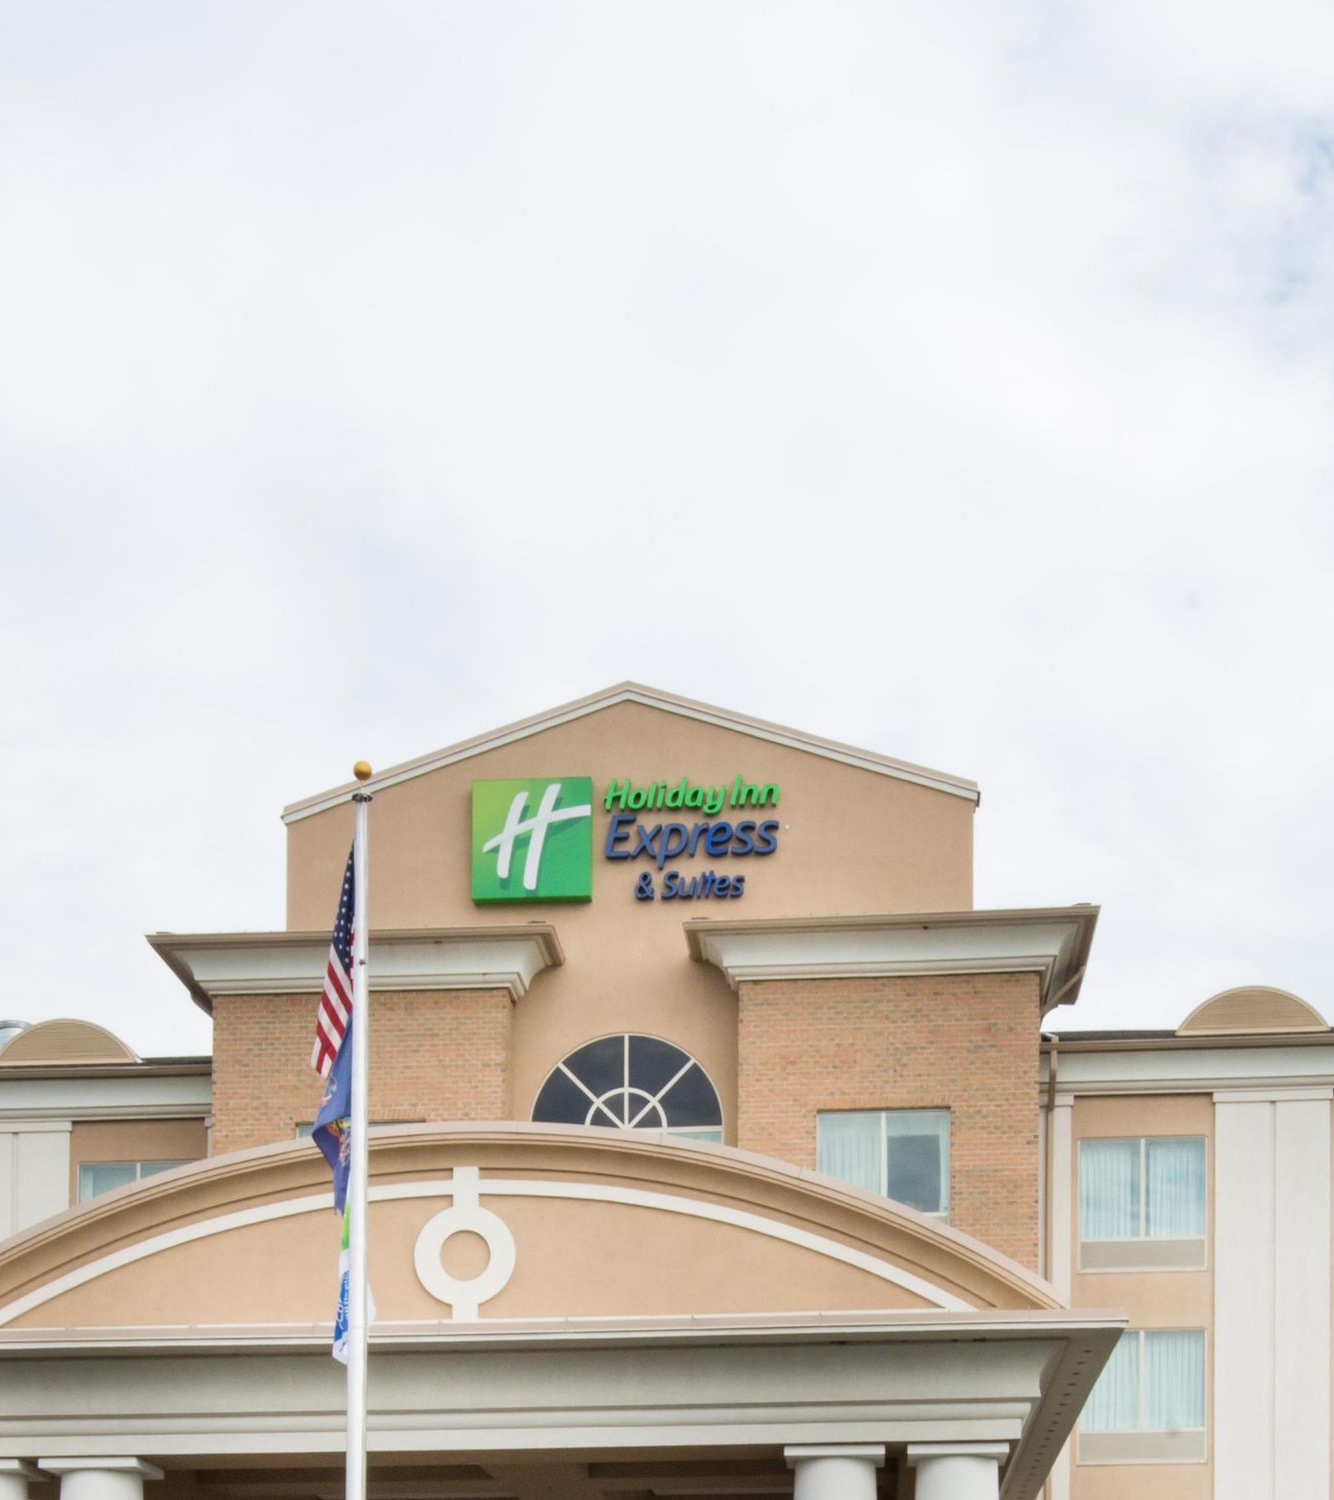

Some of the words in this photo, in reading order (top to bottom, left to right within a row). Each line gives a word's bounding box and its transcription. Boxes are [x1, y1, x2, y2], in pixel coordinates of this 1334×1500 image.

[604, 777, 726, 815] Holiday
[730, 774, 780, 807] Inn
[604, 813, 780, 870] Express
[634, 871, 655, 901] &
[661, 870, 745, 900] Suites
